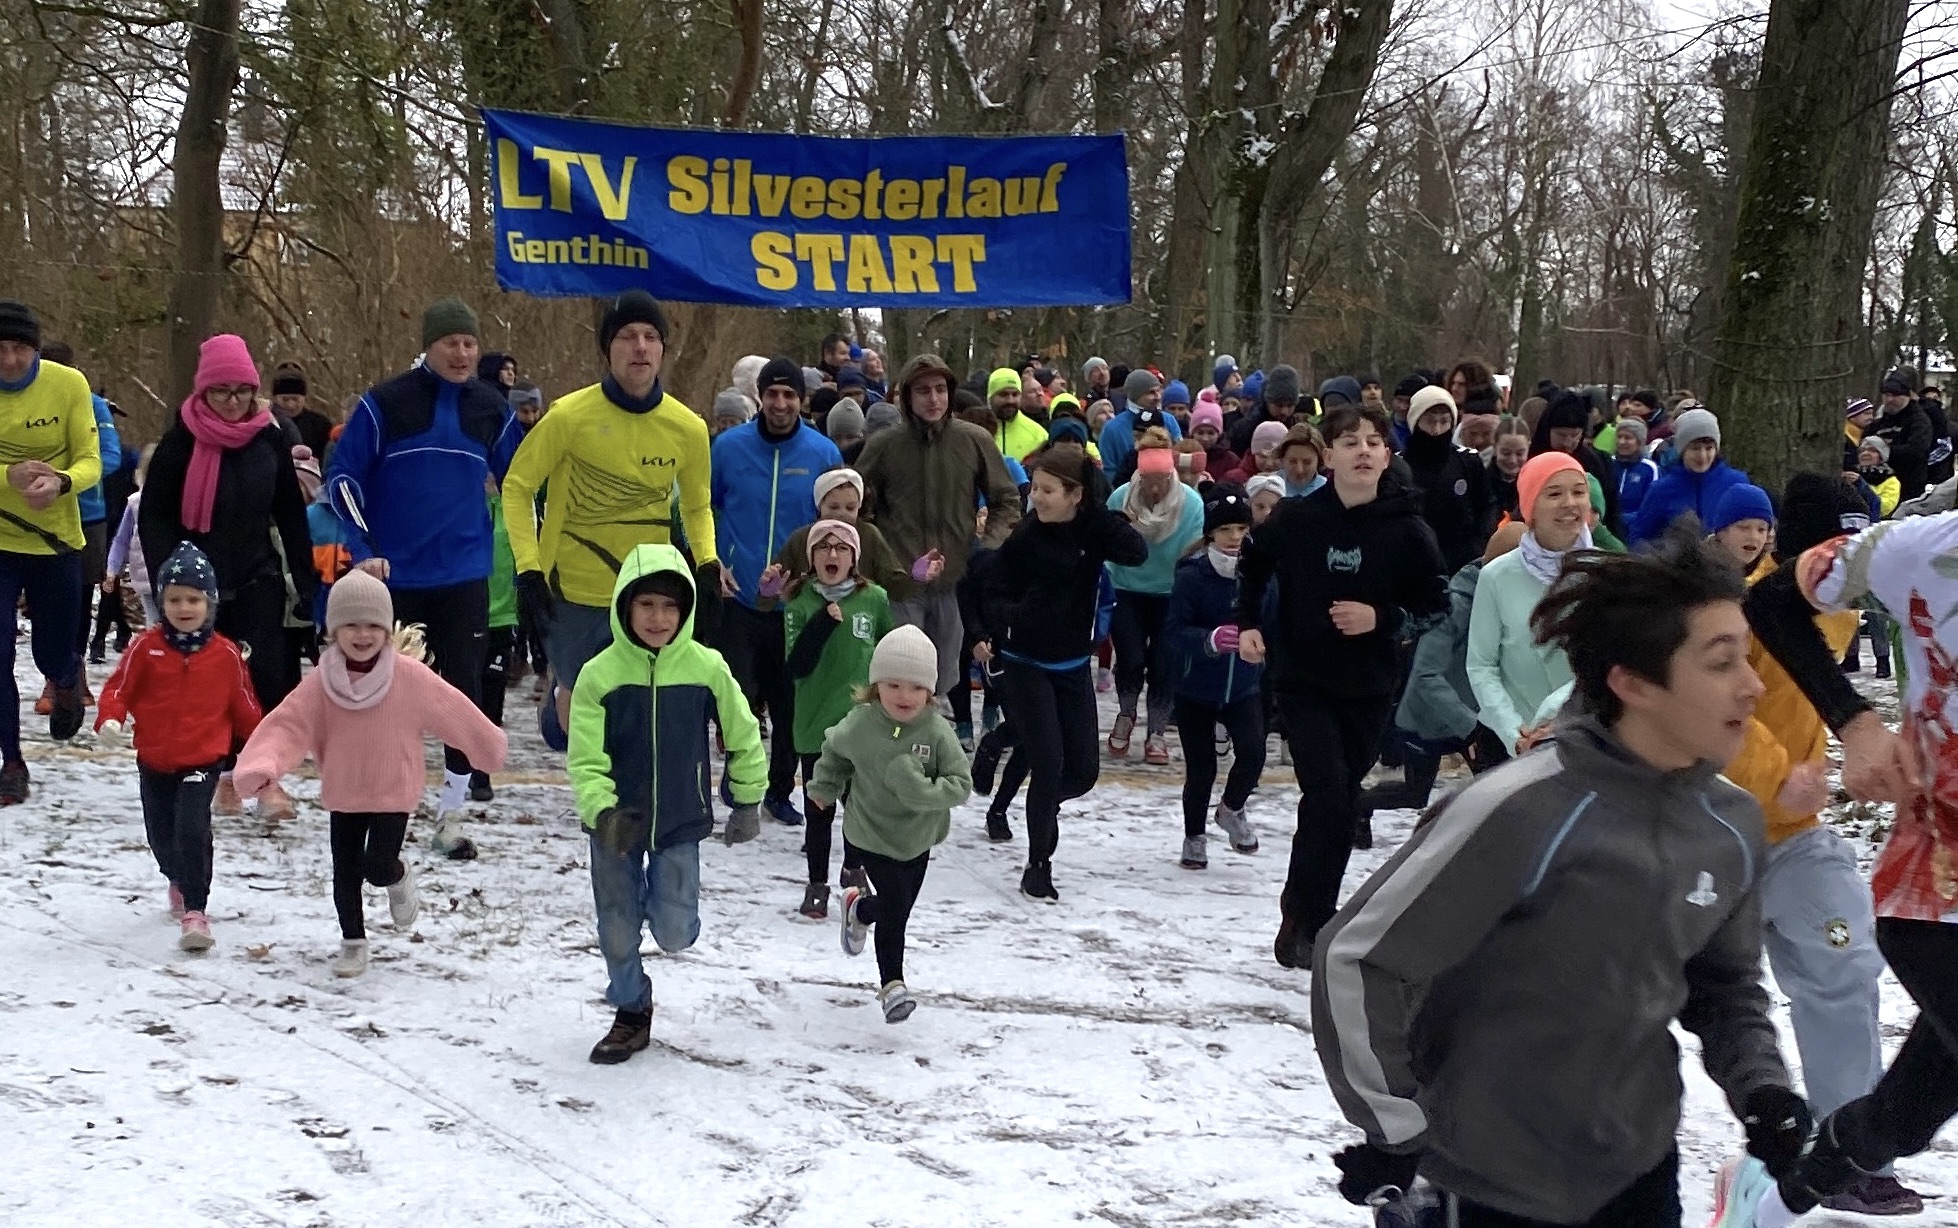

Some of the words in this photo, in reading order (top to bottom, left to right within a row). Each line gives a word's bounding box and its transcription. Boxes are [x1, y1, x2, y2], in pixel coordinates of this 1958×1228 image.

[498, 138, 638, 220] LTV
[667, 155, 1067, 220] Silvesterlauf
[507, 231, 649, 269] Genthin
[751, 231, 986, 293] START
